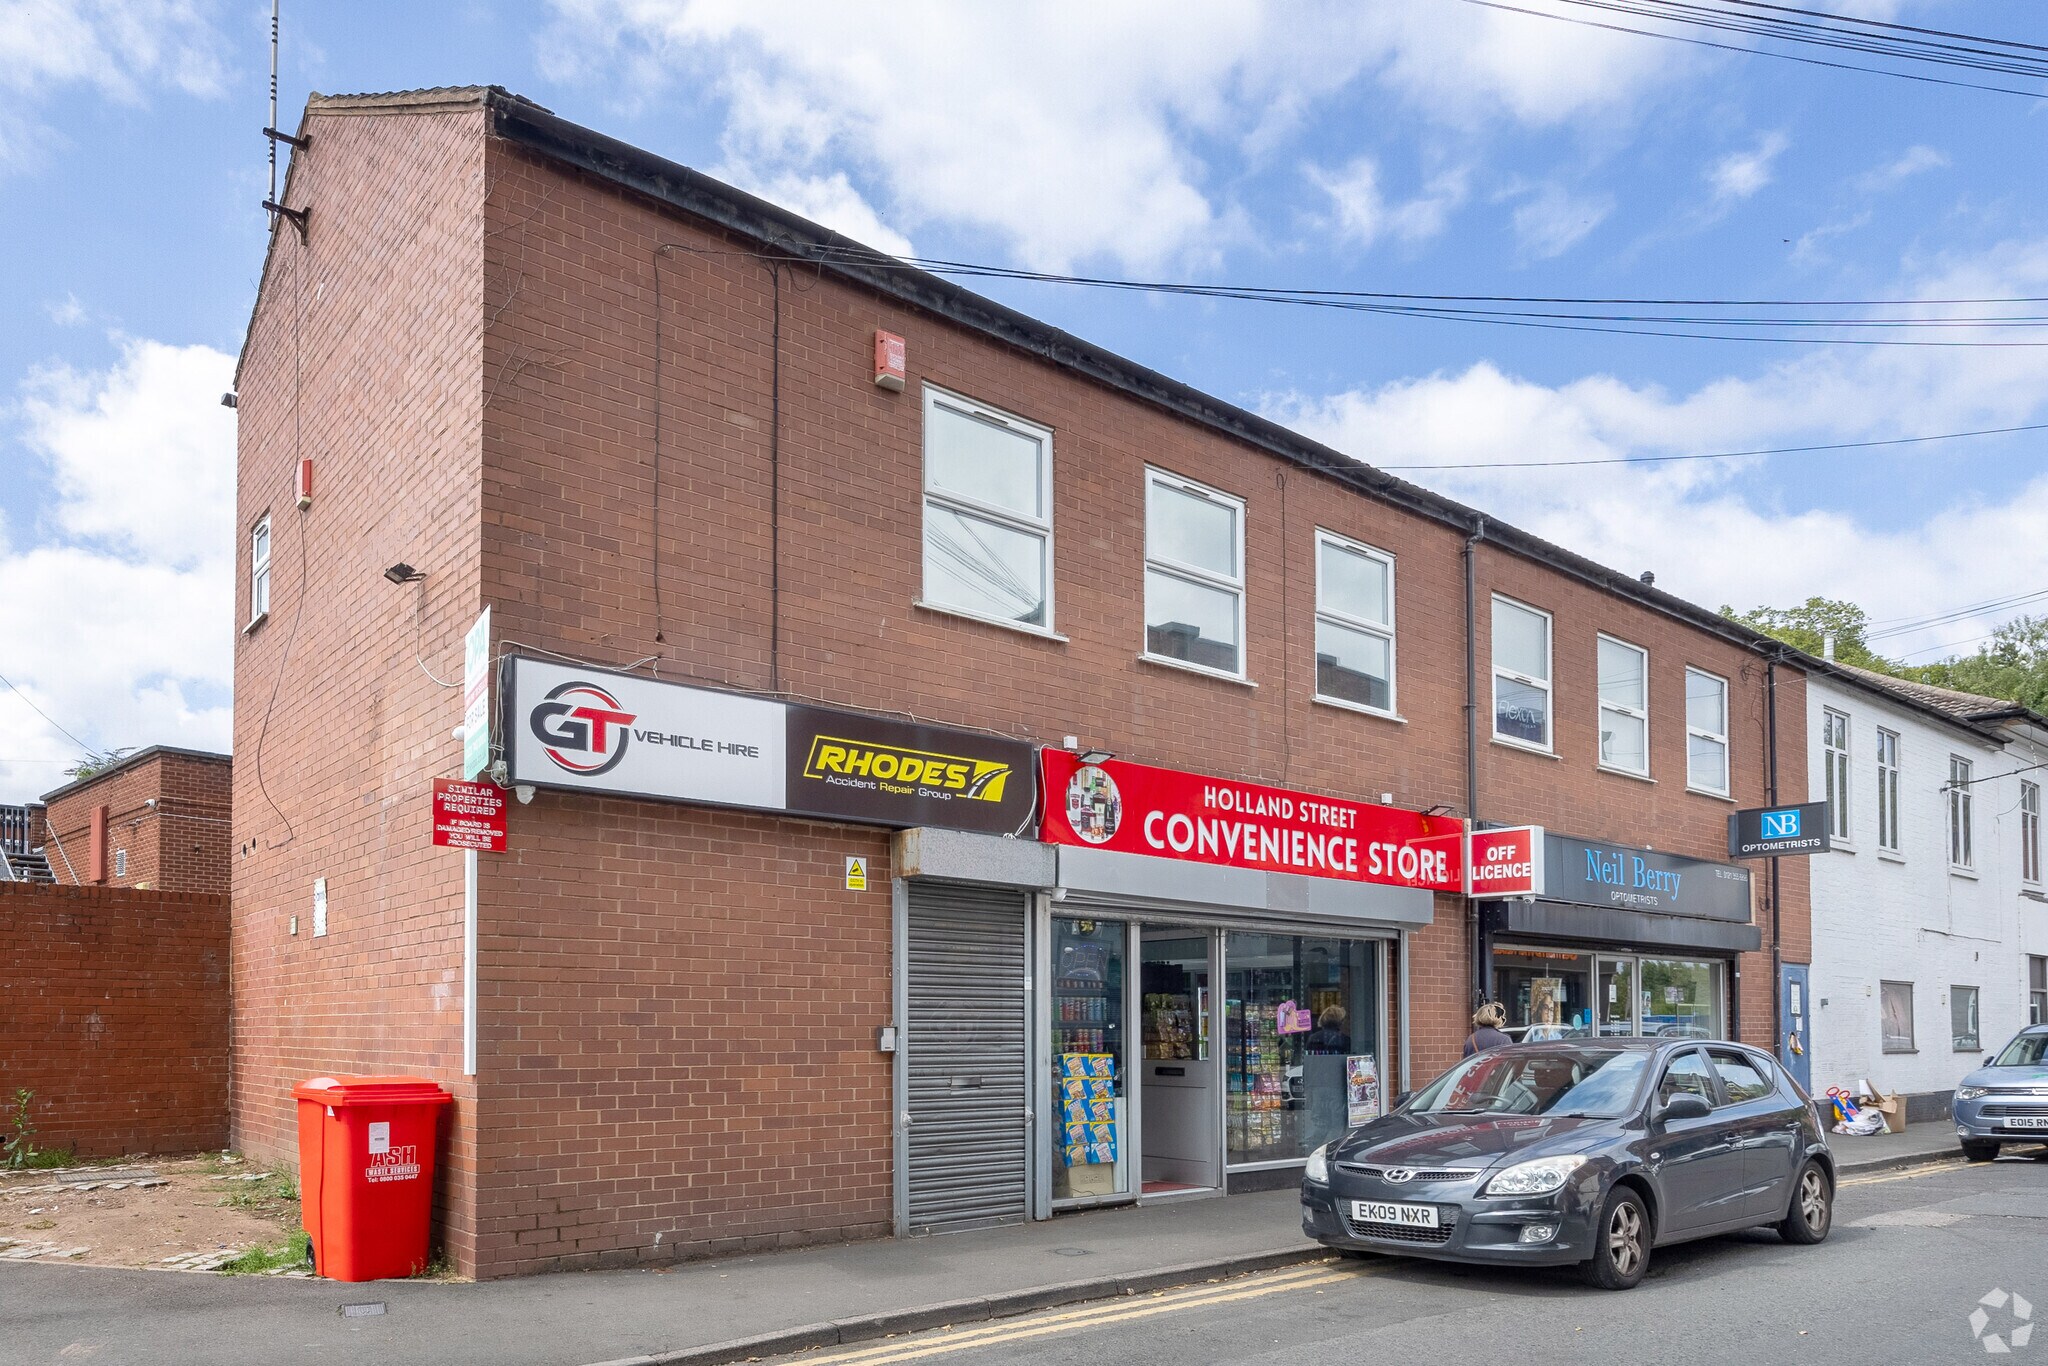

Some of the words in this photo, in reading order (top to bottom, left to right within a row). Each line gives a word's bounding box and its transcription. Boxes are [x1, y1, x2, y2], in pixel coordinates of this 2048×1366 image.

[530, 701, 638, 754] GT
[634, 728, 713, 752] VEHICLE
[717, 741, 760, 759] HIRE
[815, 744, 970, 789] RHODES
[448, 784, 493, 797] SIMILAR
[825, 774, 876, 790] Accident
[879, 782, 915, 796] Repair
[918, 787, 952, 801] Group
[437, 792, 503, 807] PROPERTIES
[443, 802, 496, 816] REQUIRED
[1204, 785, 1294, 820] HOLLAND
[1299, 800, 1358, 830] STREET
[458, 820, 482, 828] BOARD
[1765, 813, 1798, 836] NB
[447, 839, 492, 849] PROSECUTED
[449, 832, 463, 840] YOU
[1742, 838, 1821, 852] OPTOMETRISTS
[1143, 810, 1358, 874] CONVENIENCE
[1368, 841, 1448, 884] STORE
[1486, 845, 1517, 862] OFF
[1472, 862, 1532, 881] LICENCE
[1584, 848, 1625, 886] Neil
[1632, 856, 1682, 901] Berry
[1610, 891, 1659, 906] OPTOMETRISTS
[371, 1145, 416, 1167] ASH
[368, 1168, 388, 1176] WASTE
[390, 1166, 418, 1175] SERVICES
[1359, 1203, 1397, 1220] EK09
[1401, 1206, 1431, 1224] NXR
